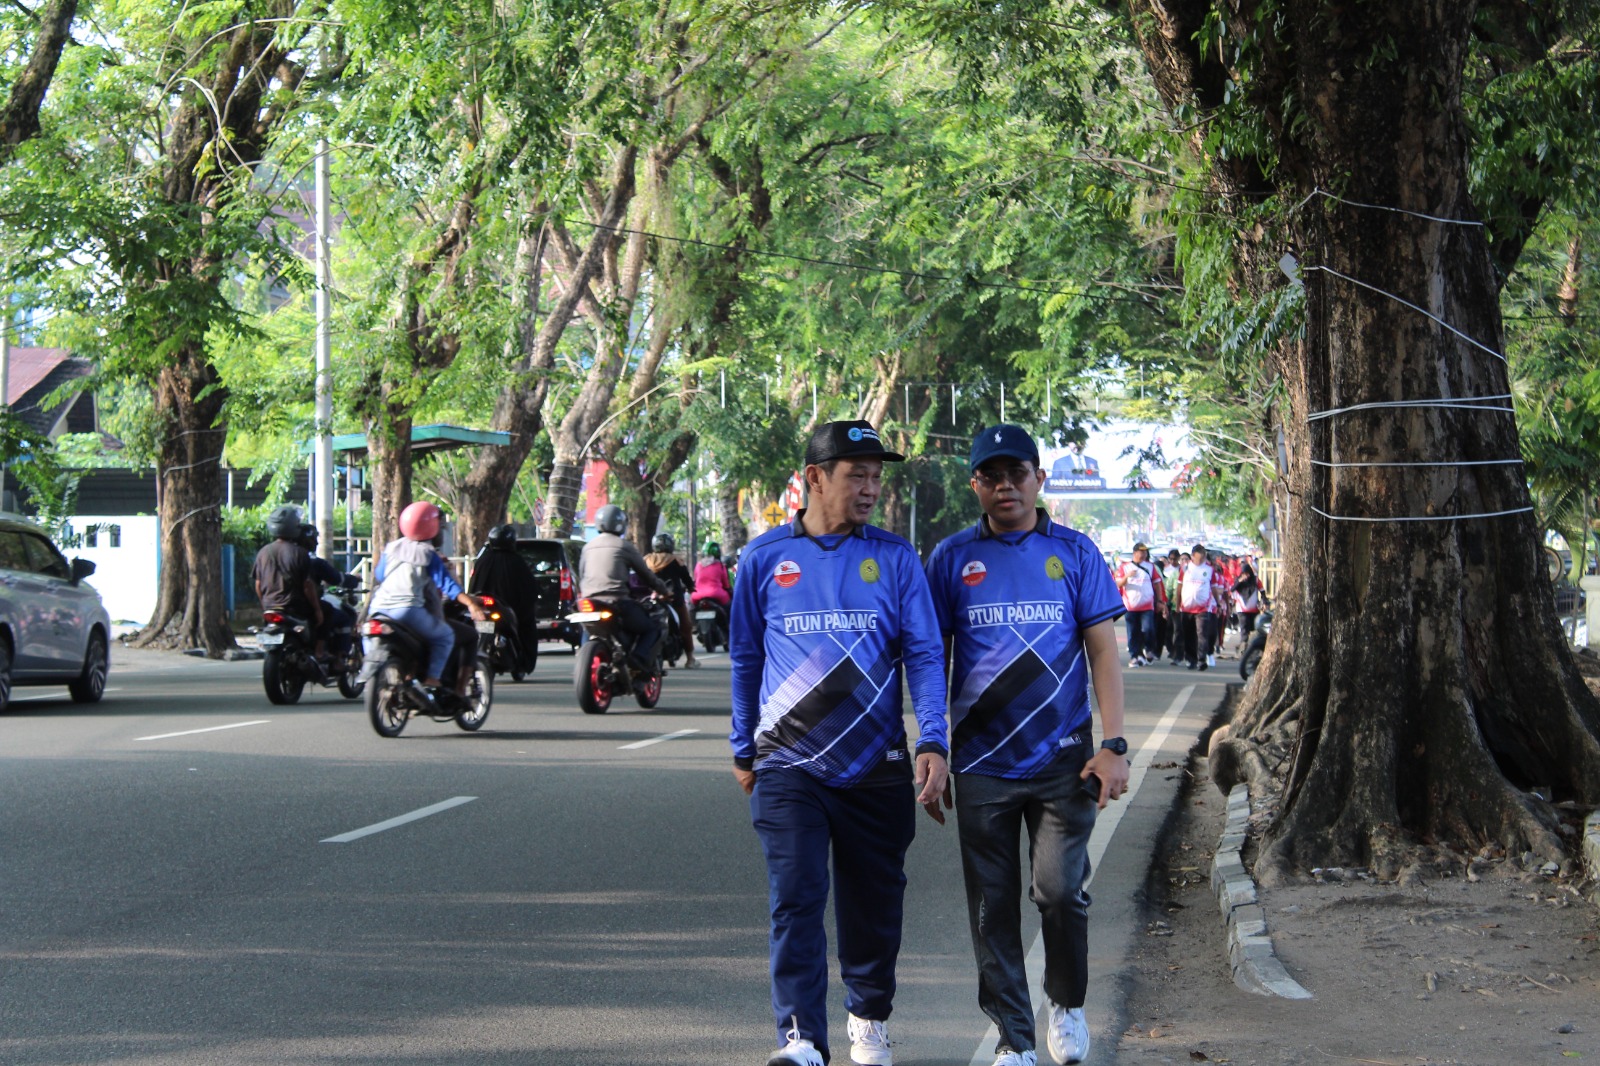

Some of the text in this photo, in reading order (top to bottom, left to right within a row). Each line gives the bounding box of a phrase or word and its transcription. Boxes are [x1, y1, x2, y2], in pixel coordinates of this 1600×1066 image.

[784, 612, 878, 633] PTUN PADANG
[968, 604, 1064, 625] PTUN PADANG
